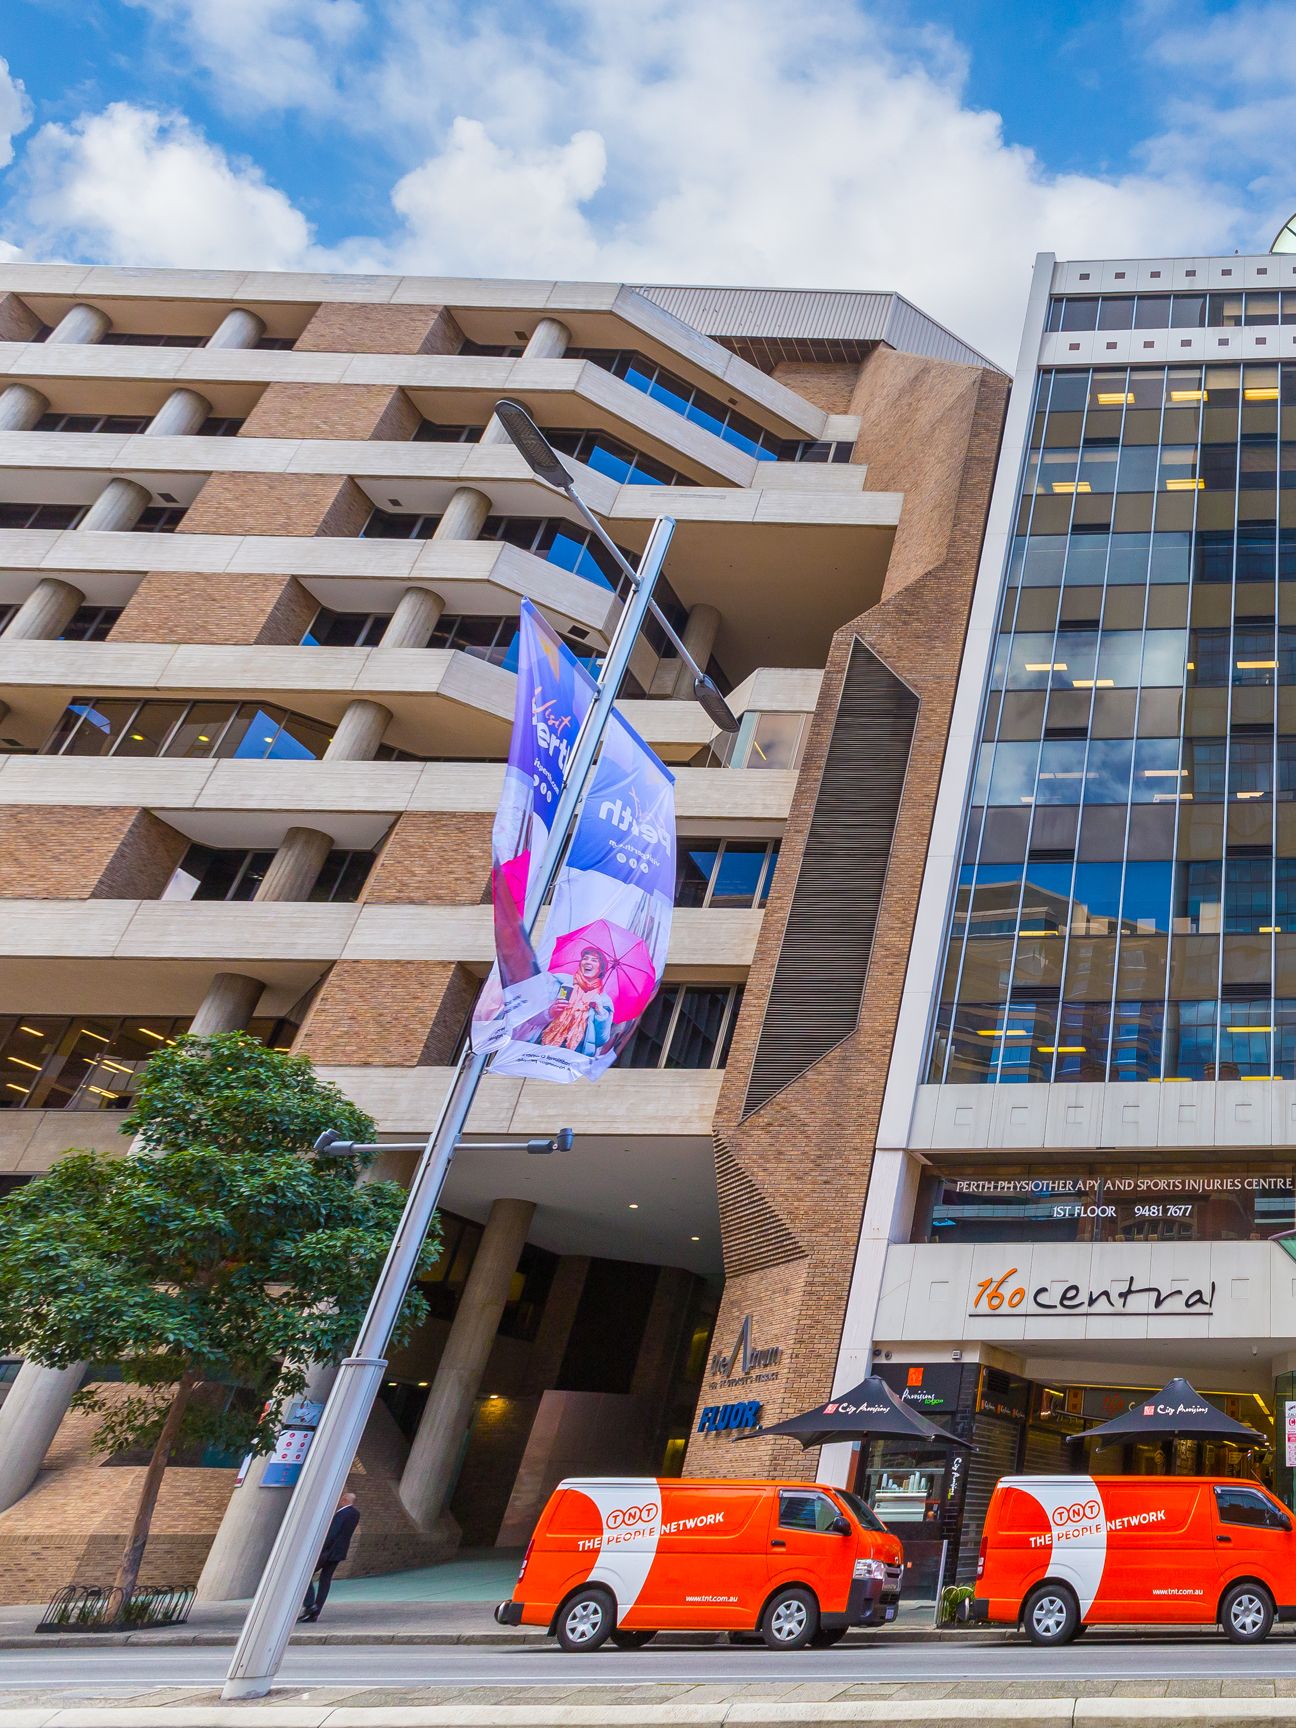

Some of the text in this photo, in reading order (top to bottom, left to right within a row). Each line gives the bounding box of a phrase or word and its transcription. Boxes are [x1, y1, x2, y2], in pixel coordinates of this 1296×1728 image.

[956, 1178, 1293, 1193] PERTH PHYSIOTHERAPY AND SPORTS INJURIES CENTRE
[1053, 1205, 1192, 1217] 1ST FLOOR 9481 7677
[973, 1267, 1216, 1310] 160 central
[902, 1387, 935, 1403] Provisions
[838, 1402, 891, 1414] City Provisions
[1157, 1404, 1208, 1416] City Provisions
[608, 1505, 657, 1527] TNT
[1054, 1501, 1099, 1525] TNT
[578, 1512, 724, 1552] THE PEOPLE NETWORK
[1029, 1510, 1166, 1548] THE PEOPLE NETWORK
